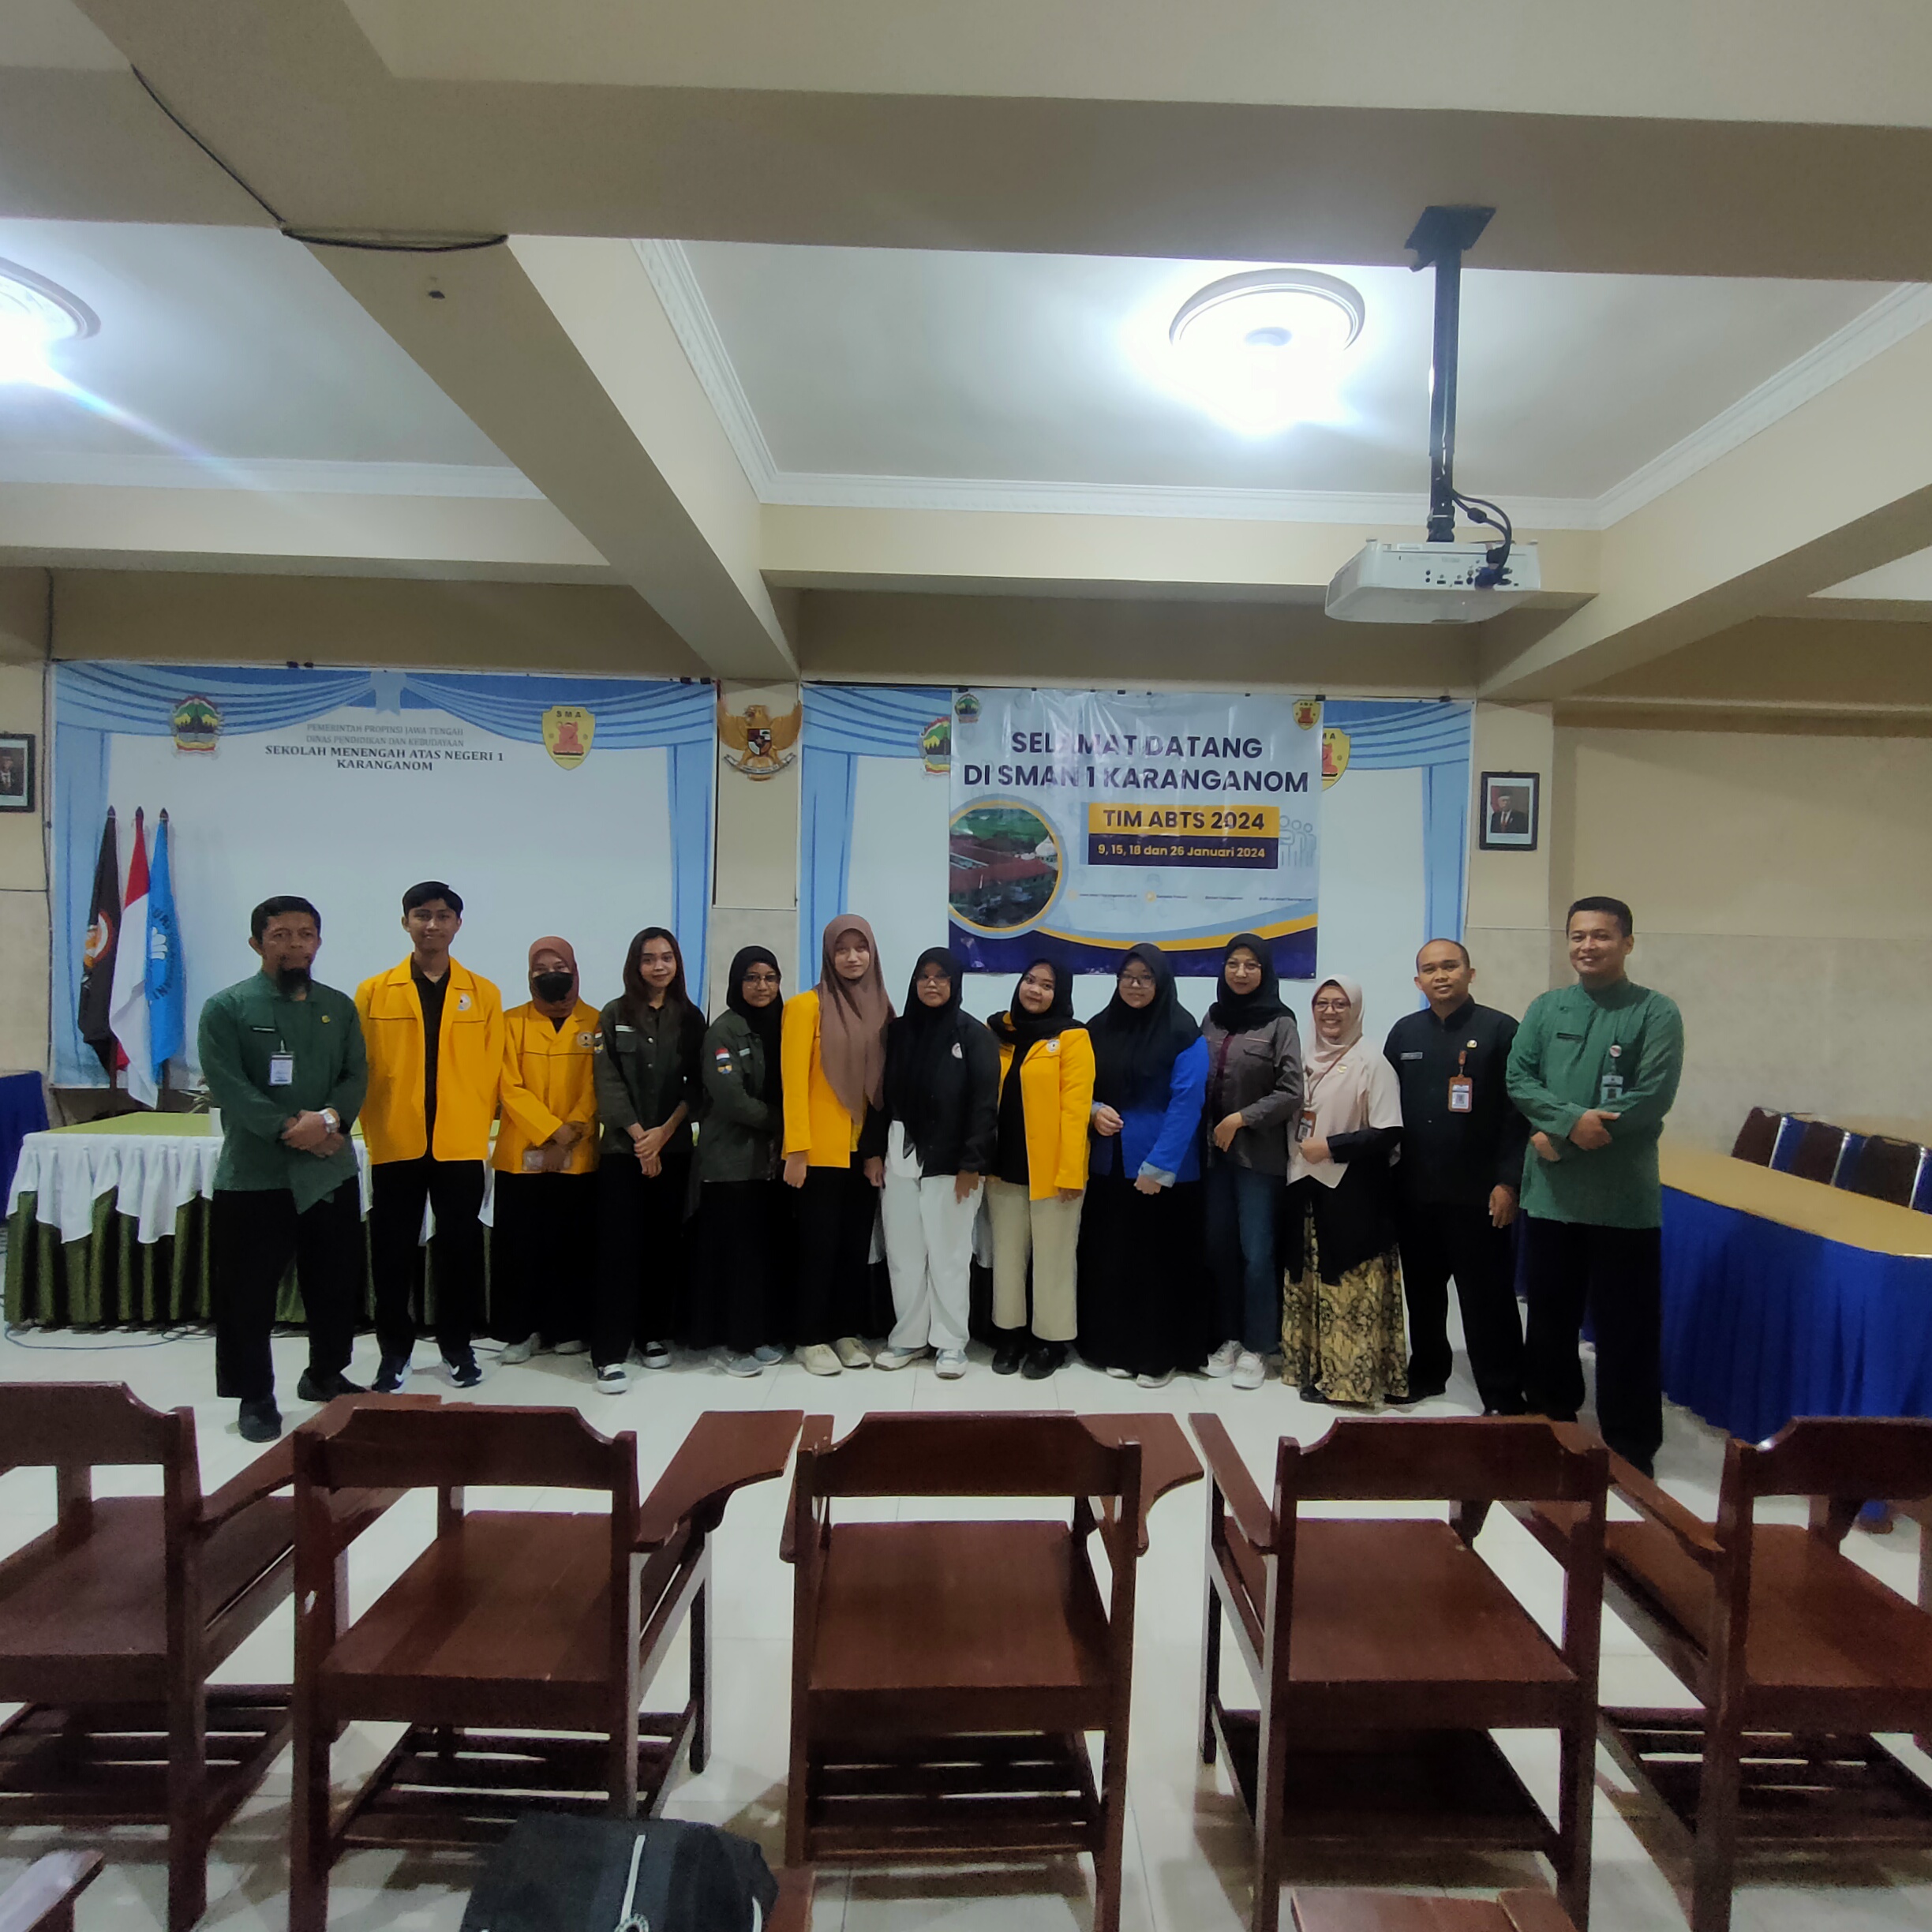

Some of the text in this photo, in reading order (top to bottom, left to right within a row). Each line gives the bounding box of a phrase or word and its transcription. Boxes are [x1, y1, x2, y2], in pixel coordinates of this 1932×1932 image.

[306, 724, 463, 736] PEMERINTAH PROPINSI JAWA TENGAH
[305, 735, 464, 747] DINAS PENDIDIKAN DAN KEBUDAYAAN
[1011, 732, 1263, 758] SELMAT DATANG
[265, 745, 504, 762] SEKOLAH MENENGAH ATAS NEGERI 1
[336, 758, 433, 771] KARANGANOM
[964, 764, 1309, 793] DI SMAN 1 KARANGANOM
[1103, 810, 1265, 831] TIM ABTS 2024
[1098, 844, 1109, 856] 9,
[1111, 844, 1126, 856] 15,
[1144, 845, 1168, 856] dan
[1170, 846, 1184, 856] 26
[1187, 846, 1235, 858] Januari
[1237, 847, 1265, 859] 2024
